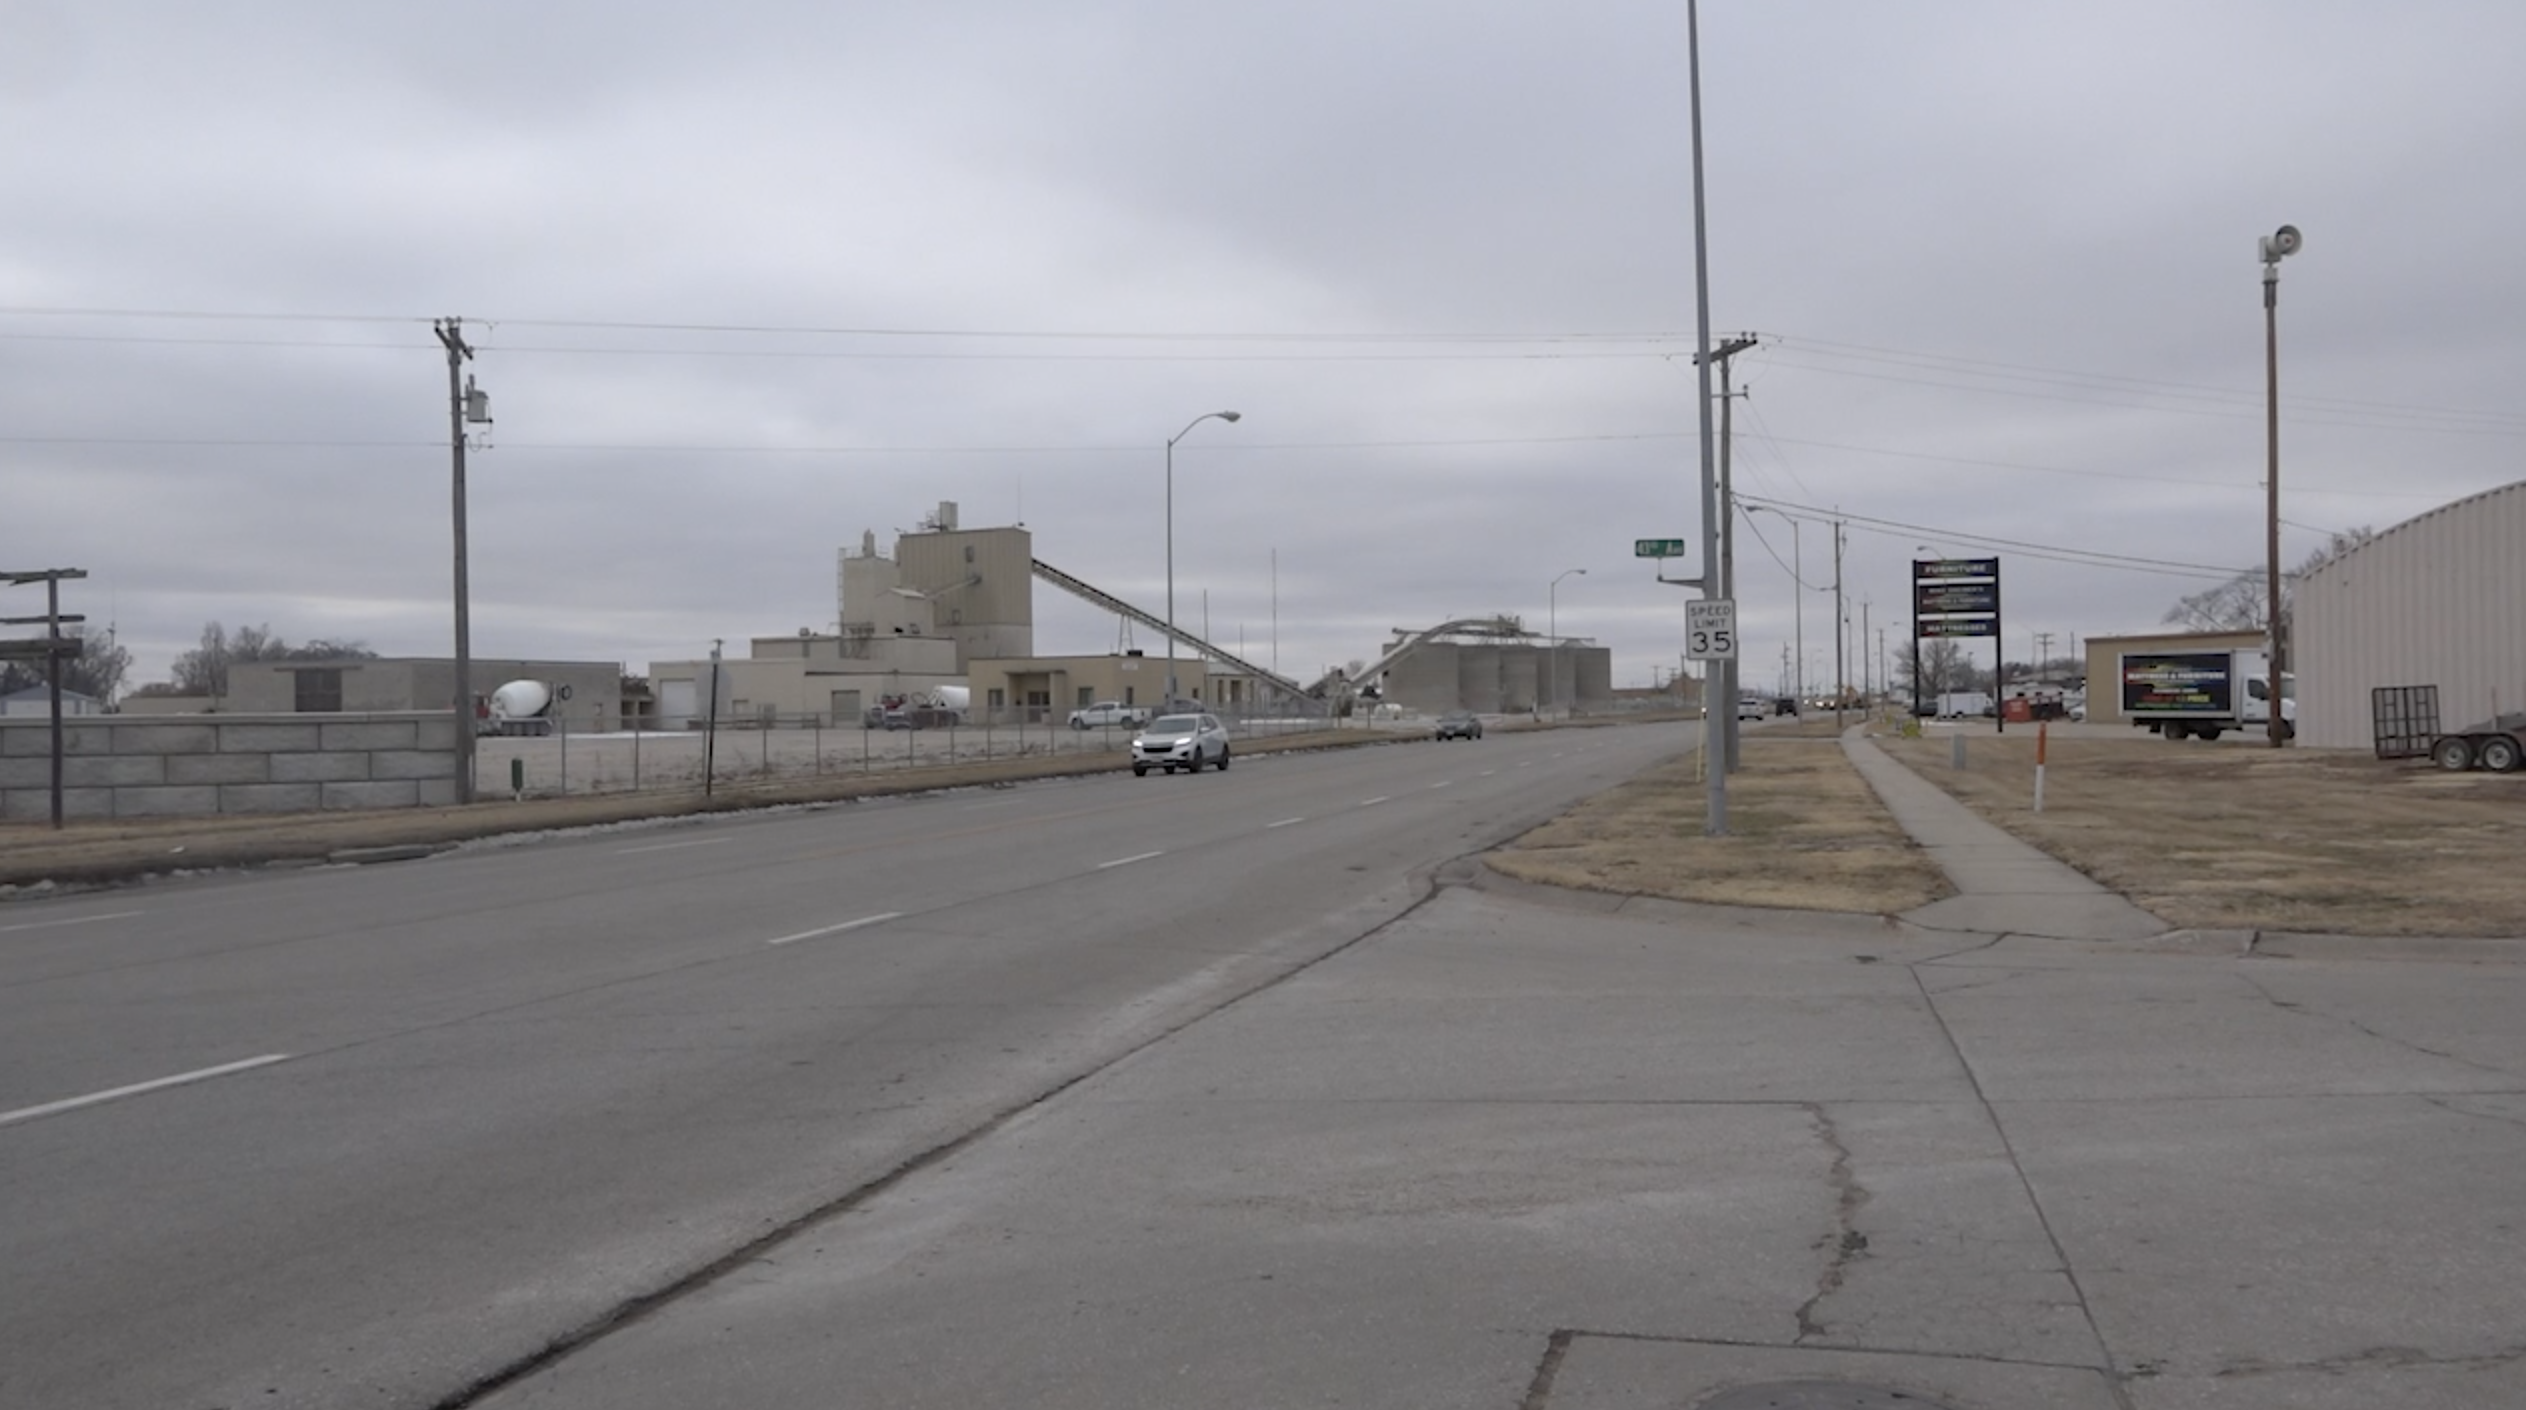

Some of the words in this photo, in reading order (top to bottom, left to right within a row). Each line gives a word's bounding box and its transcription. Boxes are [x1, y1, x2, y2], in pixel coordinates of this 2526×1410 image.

[1925, 564, 1986, 573] FURNITURE
[1690, 606, 1731, 616] SPEED
[1694, 619, 1727, 628] LIMIT
[1692, 631, 1731, 653] 35
